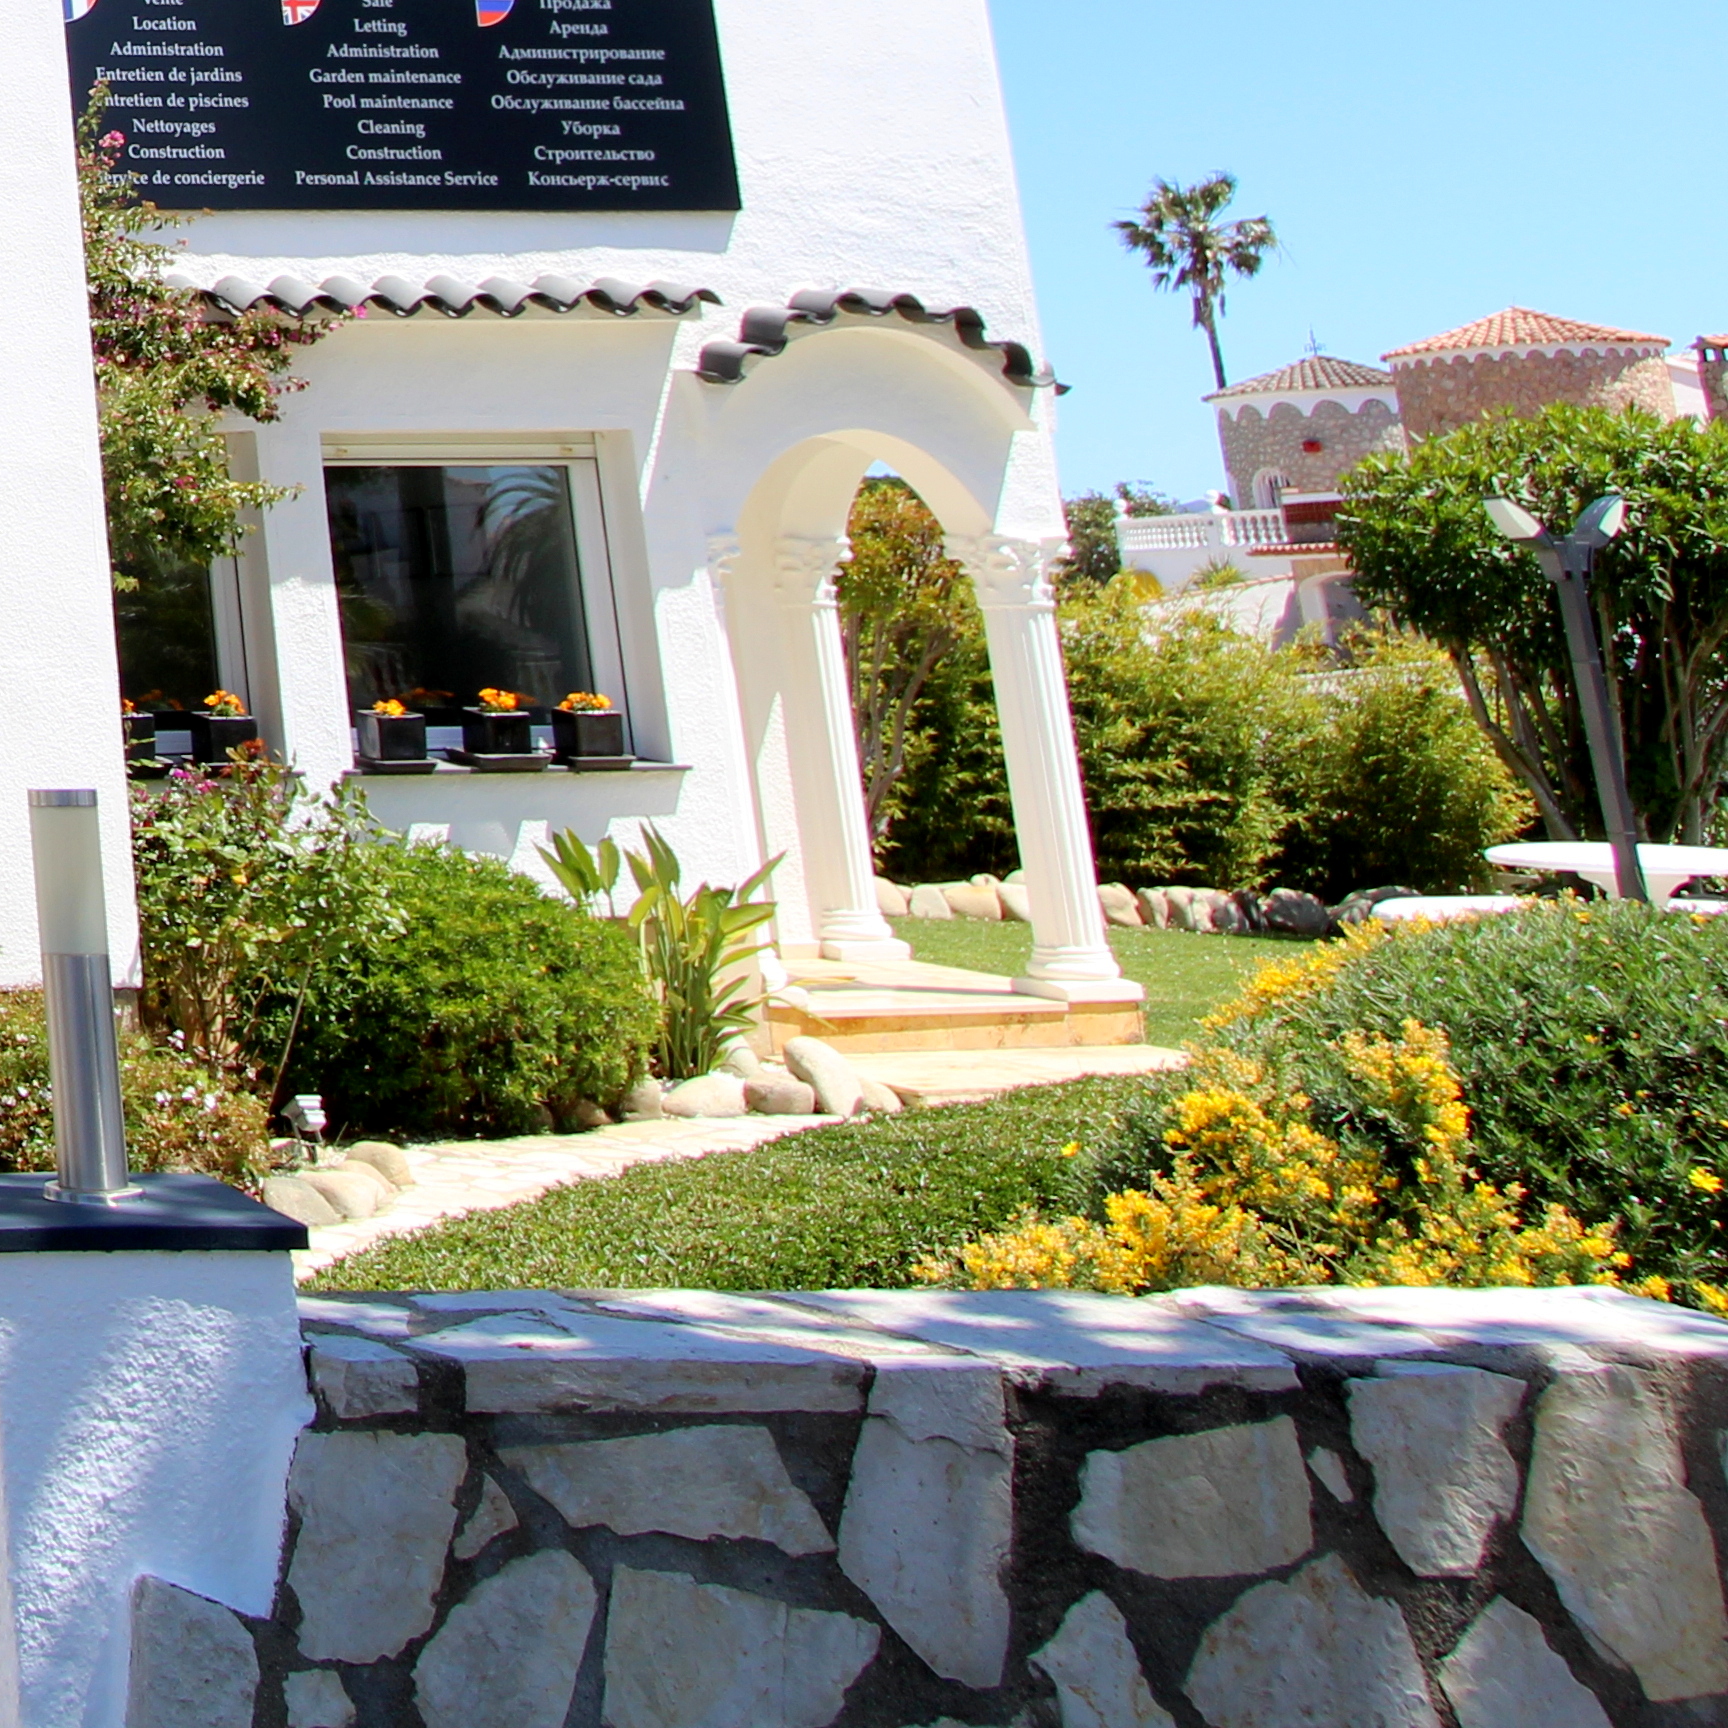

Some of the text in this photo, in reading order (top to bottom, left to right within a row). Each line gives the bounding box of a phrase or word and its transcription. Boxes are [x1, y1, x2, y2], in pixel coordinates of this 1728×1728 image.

[133, 16, 196, 30] Location
[354, 19, 407, 37] Letting
[111, 41, 223, 56] Administration
[327, 44, 439, 58] Administration
[96, 67, 242, 85] Entretien de jardins
[310, 69, 461, 83] Garden maintenance
[96, 92, 249, 111] ntretien de piscines
[323, 94, 453, 109] Pool maintenance
[133, 119, 215, 137] Nettoyages
[358, 120, 425, 138] Cleaning
[128, 144, 225, 158] Construction
[346, 145, 442, 159] Construction
[153, 170, 170, 184] de
[174, 170, 264, 189] conciergerie
[295, 171, 498, 185] Personal Assistance Service
